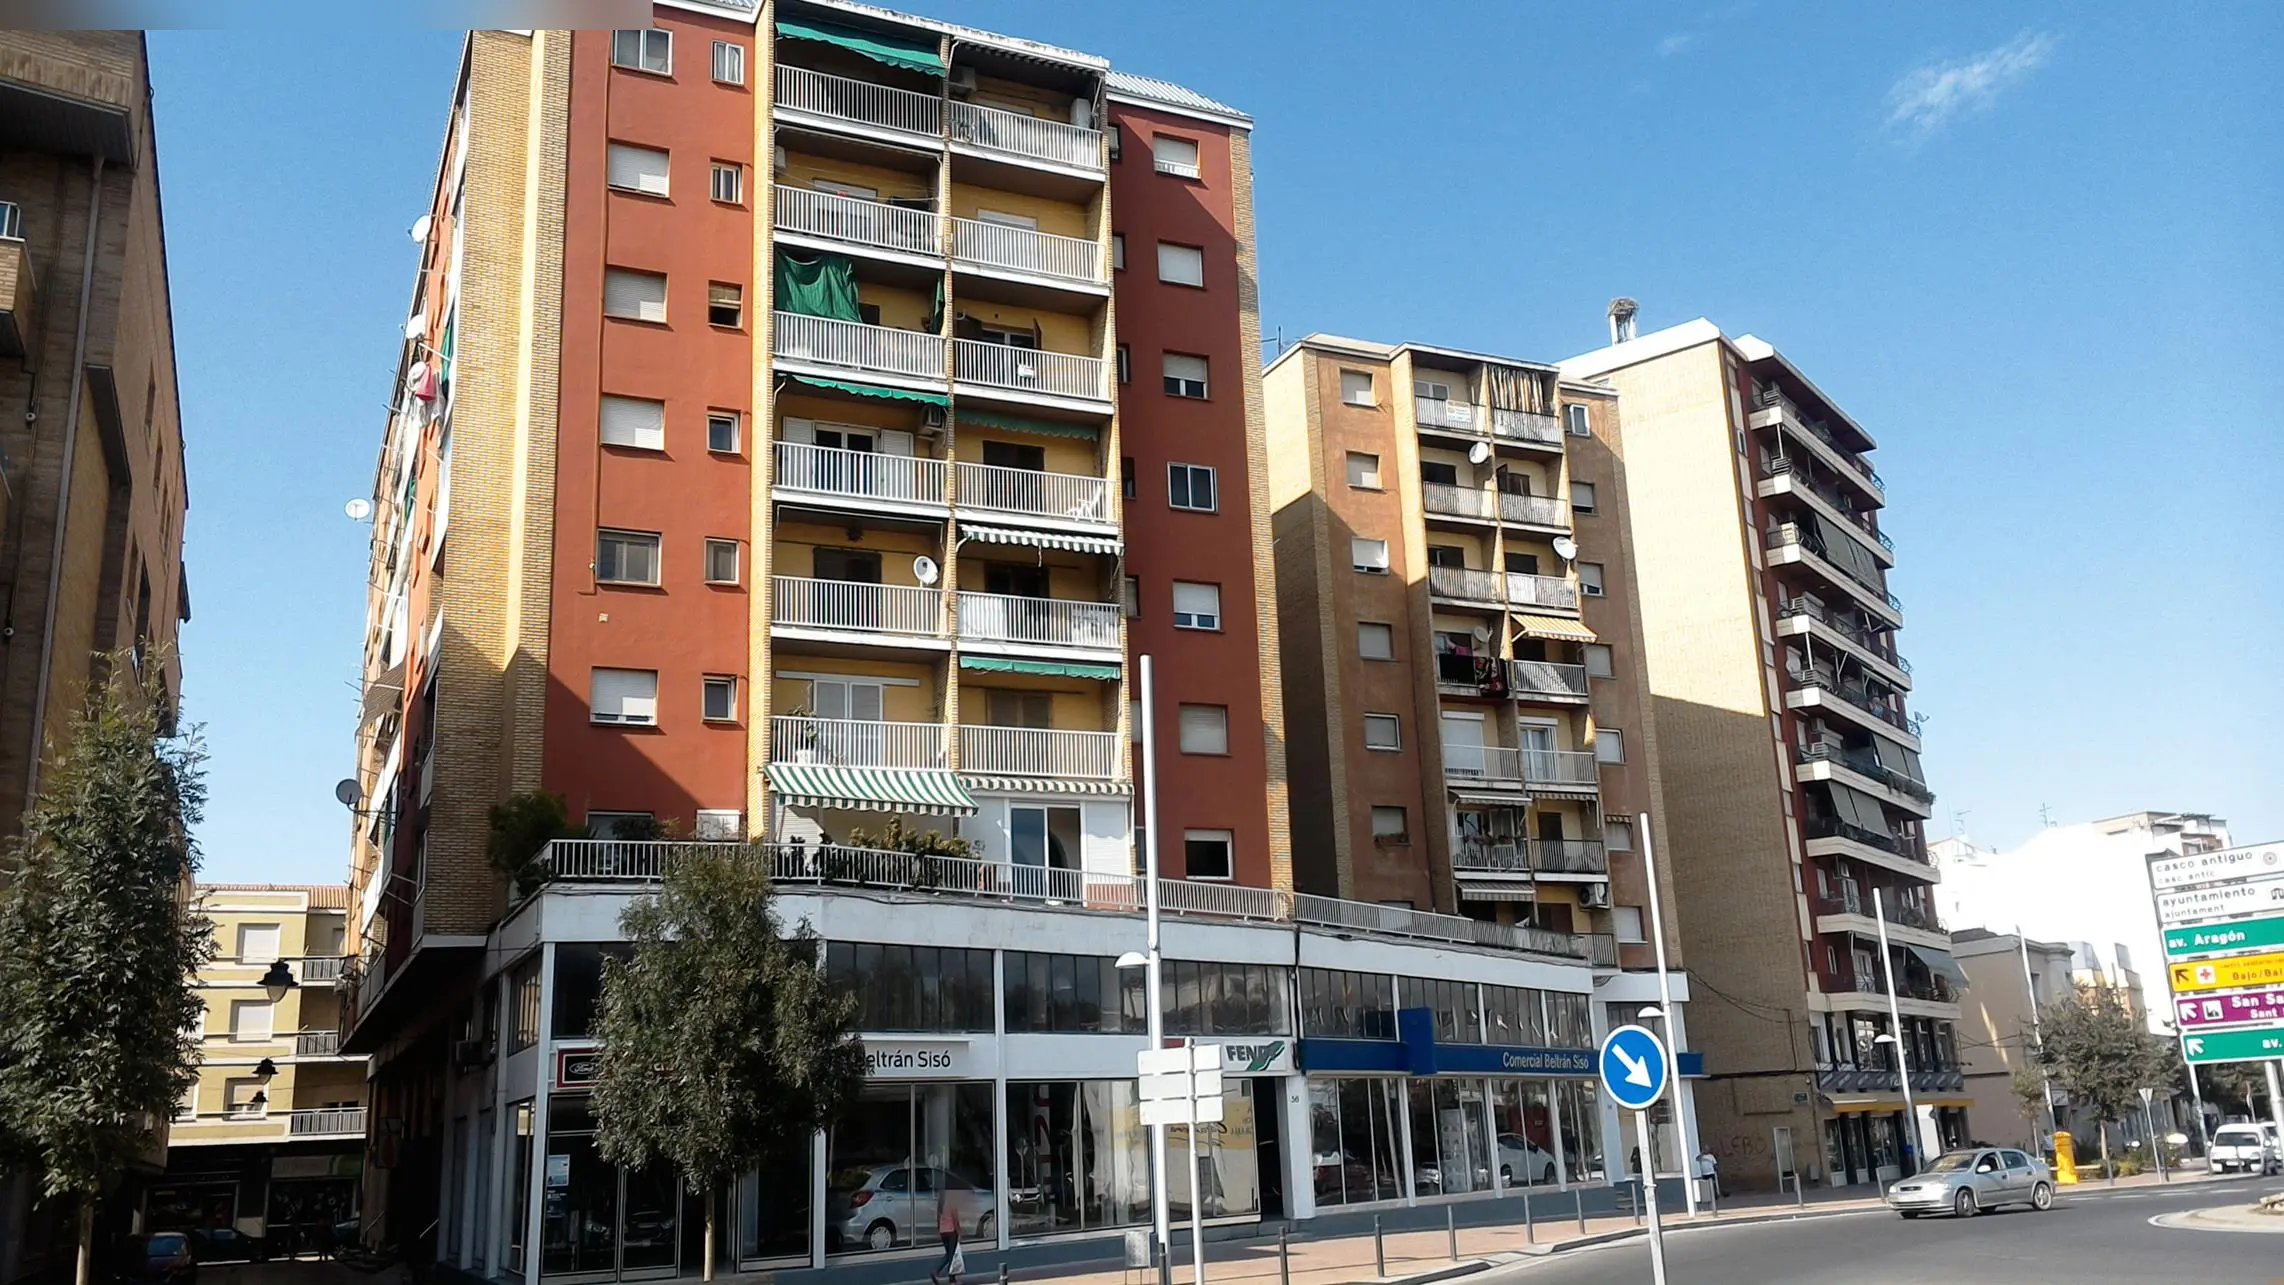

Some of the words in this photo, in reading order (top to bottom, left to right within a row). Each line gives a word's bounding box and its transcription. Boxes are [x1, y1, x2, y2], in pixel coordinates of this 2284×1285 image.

[2156, 860, 2195, 872] casco
[2201, 851, 2253, 866] antiguo
[2163, 887, 2256, 907] ayuntamiento
[2165, 904, 2225, 919] ajuntament
[2168, 937, 2187, 949] av.
[2194, 929, 2246, 946] Aragón
[2231, 995, 2260, 1008] San
[2250, 1007, 2278, 1018] Sant
[2262, 1038, 2283, 1049] av.
[866, 1049, 913, 1068] eltrán
[917, 1049, 951, 1068] Sisó
[1503, 1051, 1543, 1069] Comercial
[1544, 1053, 1572, 1069] Beltrán
[1573, 1054, 1589, 1069] Sisó
